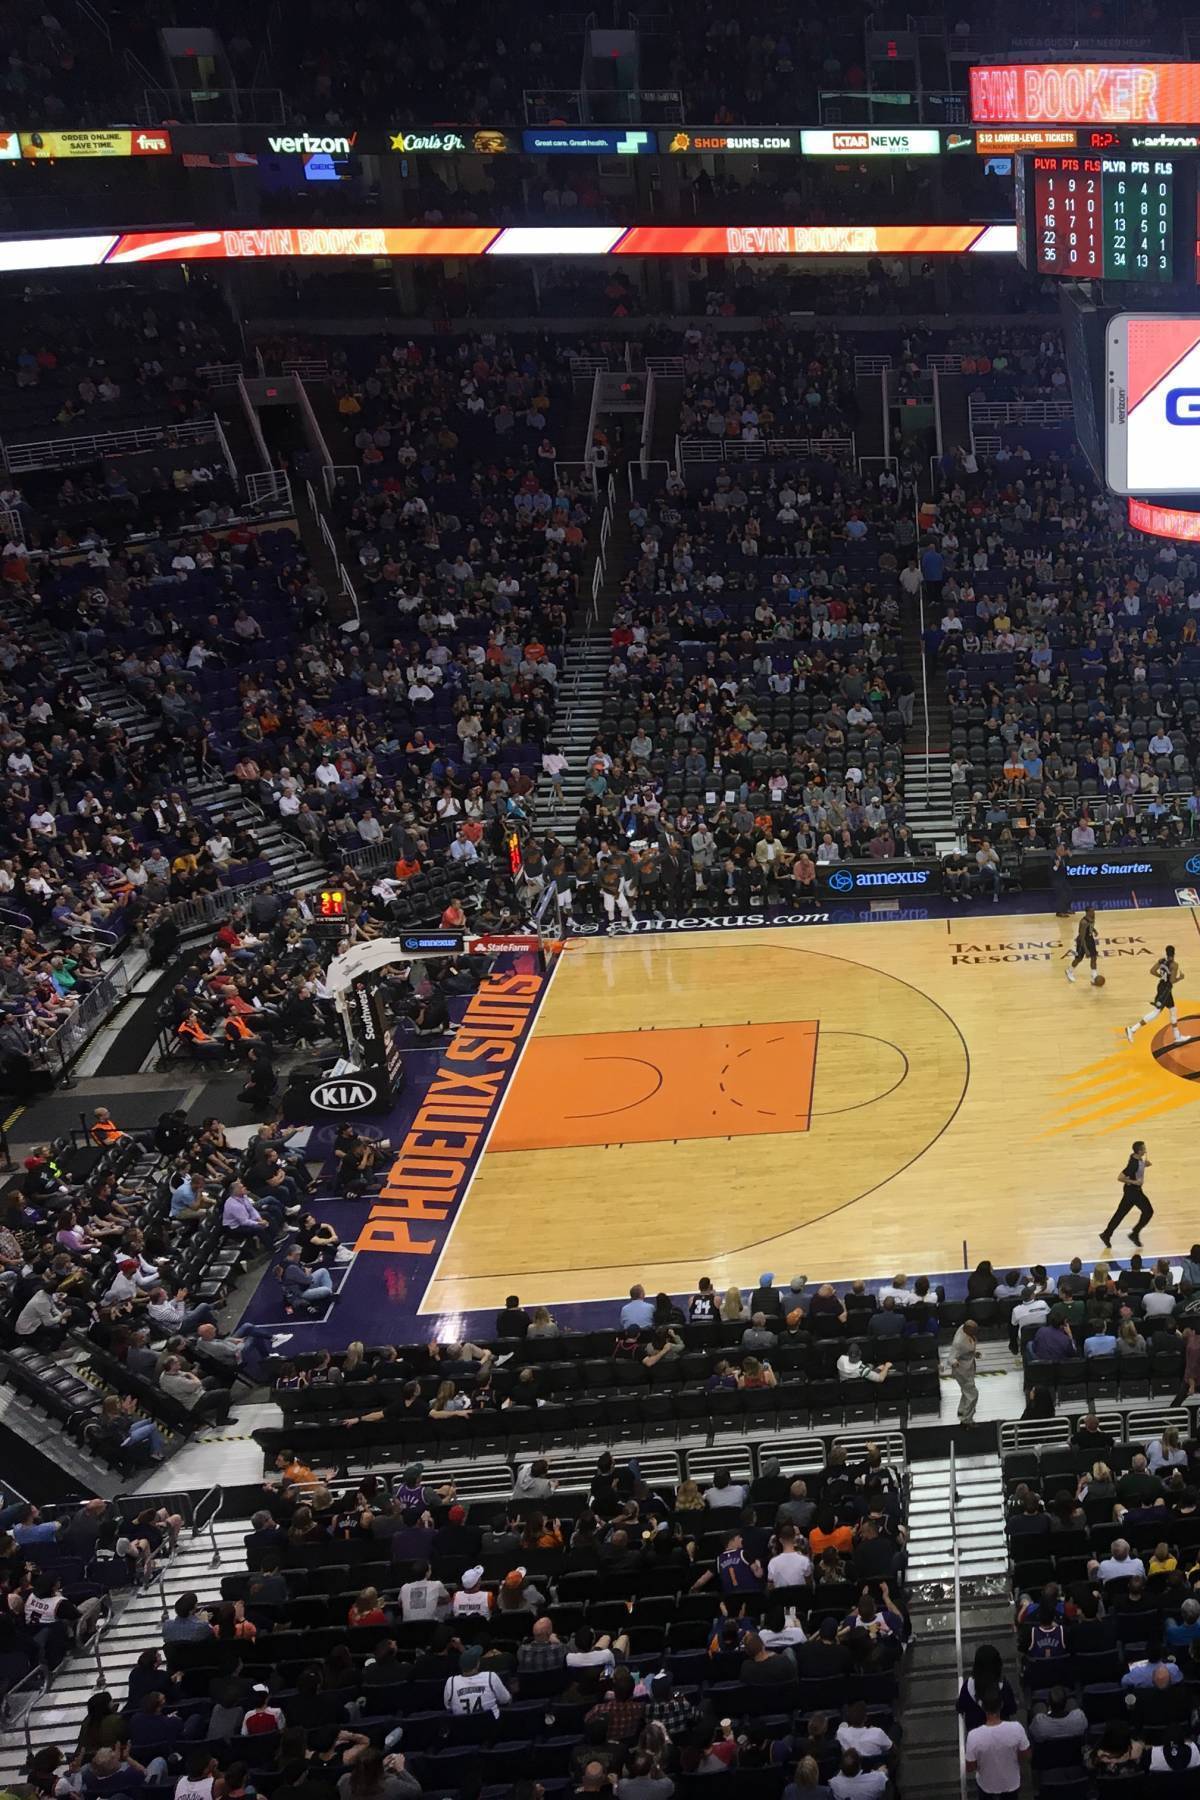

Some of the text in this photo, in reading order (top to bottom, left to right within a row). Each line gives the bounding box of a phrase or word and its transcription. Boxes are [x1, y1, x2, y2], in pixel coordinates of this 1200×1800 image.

[1024, 68, 1159, 121] BOOKER
[61, 133, 122, 142] ORDER ONLINE.
[268, 132, 350, 153] verizon
[403, 134, 467, 151] Carl's Jr.
[587, 138, 608, 147] health.
[694, 138, 791, 149] SHOPSUNS.COM
[834, 135, 910, 147] KTAR NEWS
[978, 133, 1074, 143] $12 LOWER-LEVEL TICKETS
[1035, 158, 1101, 171] PLYR PTS FLS
[1103, 160, 1172, 174] PLYR PTS FLS
[1048, 178, 1094, 193] 1 9 2
[1118, 181, 1166, 196] 6 4 0
[1048, 197, 1094, 212] 3 11 0
[1114, 201, 1166, 216] 11 8 0
[1044, 214, 1093, 229] 16 7 1
[1114, 218, 1166, 234] 13 5 0
[225, 228, 387, 257] DEVIN BOOKER
[727, 227, 877, 252] DEVIN BOOKER
[1044, 231, 1093, 246] 22 8 1
[1113, 235, 1165, 251] 22 4 1
[1044, 248, 1095, 263] 35 0 3
[1113, 252, 1167, 268] 34 13 3
[1118, 391, 1126, 425] verizon
[1100, 863, 1153, 876] Smarter.
[856, 871, 928, 887] annexus
[948, 939, 1064, 954] TALKING
[951, 952, 1055, 965] RESORT
[357, 990, 376, 1040] Southwest
[322, 1087, 365, 1105] KIA
[352, 973, 543, 1255] PHOENIX SUNS
[694, 1299, 711, 1315] 34
[728, 1567, 738, 1586] 1
[30, 1599, 50, 1611] KIDD
[460, 1696, 482, 1714] 34
